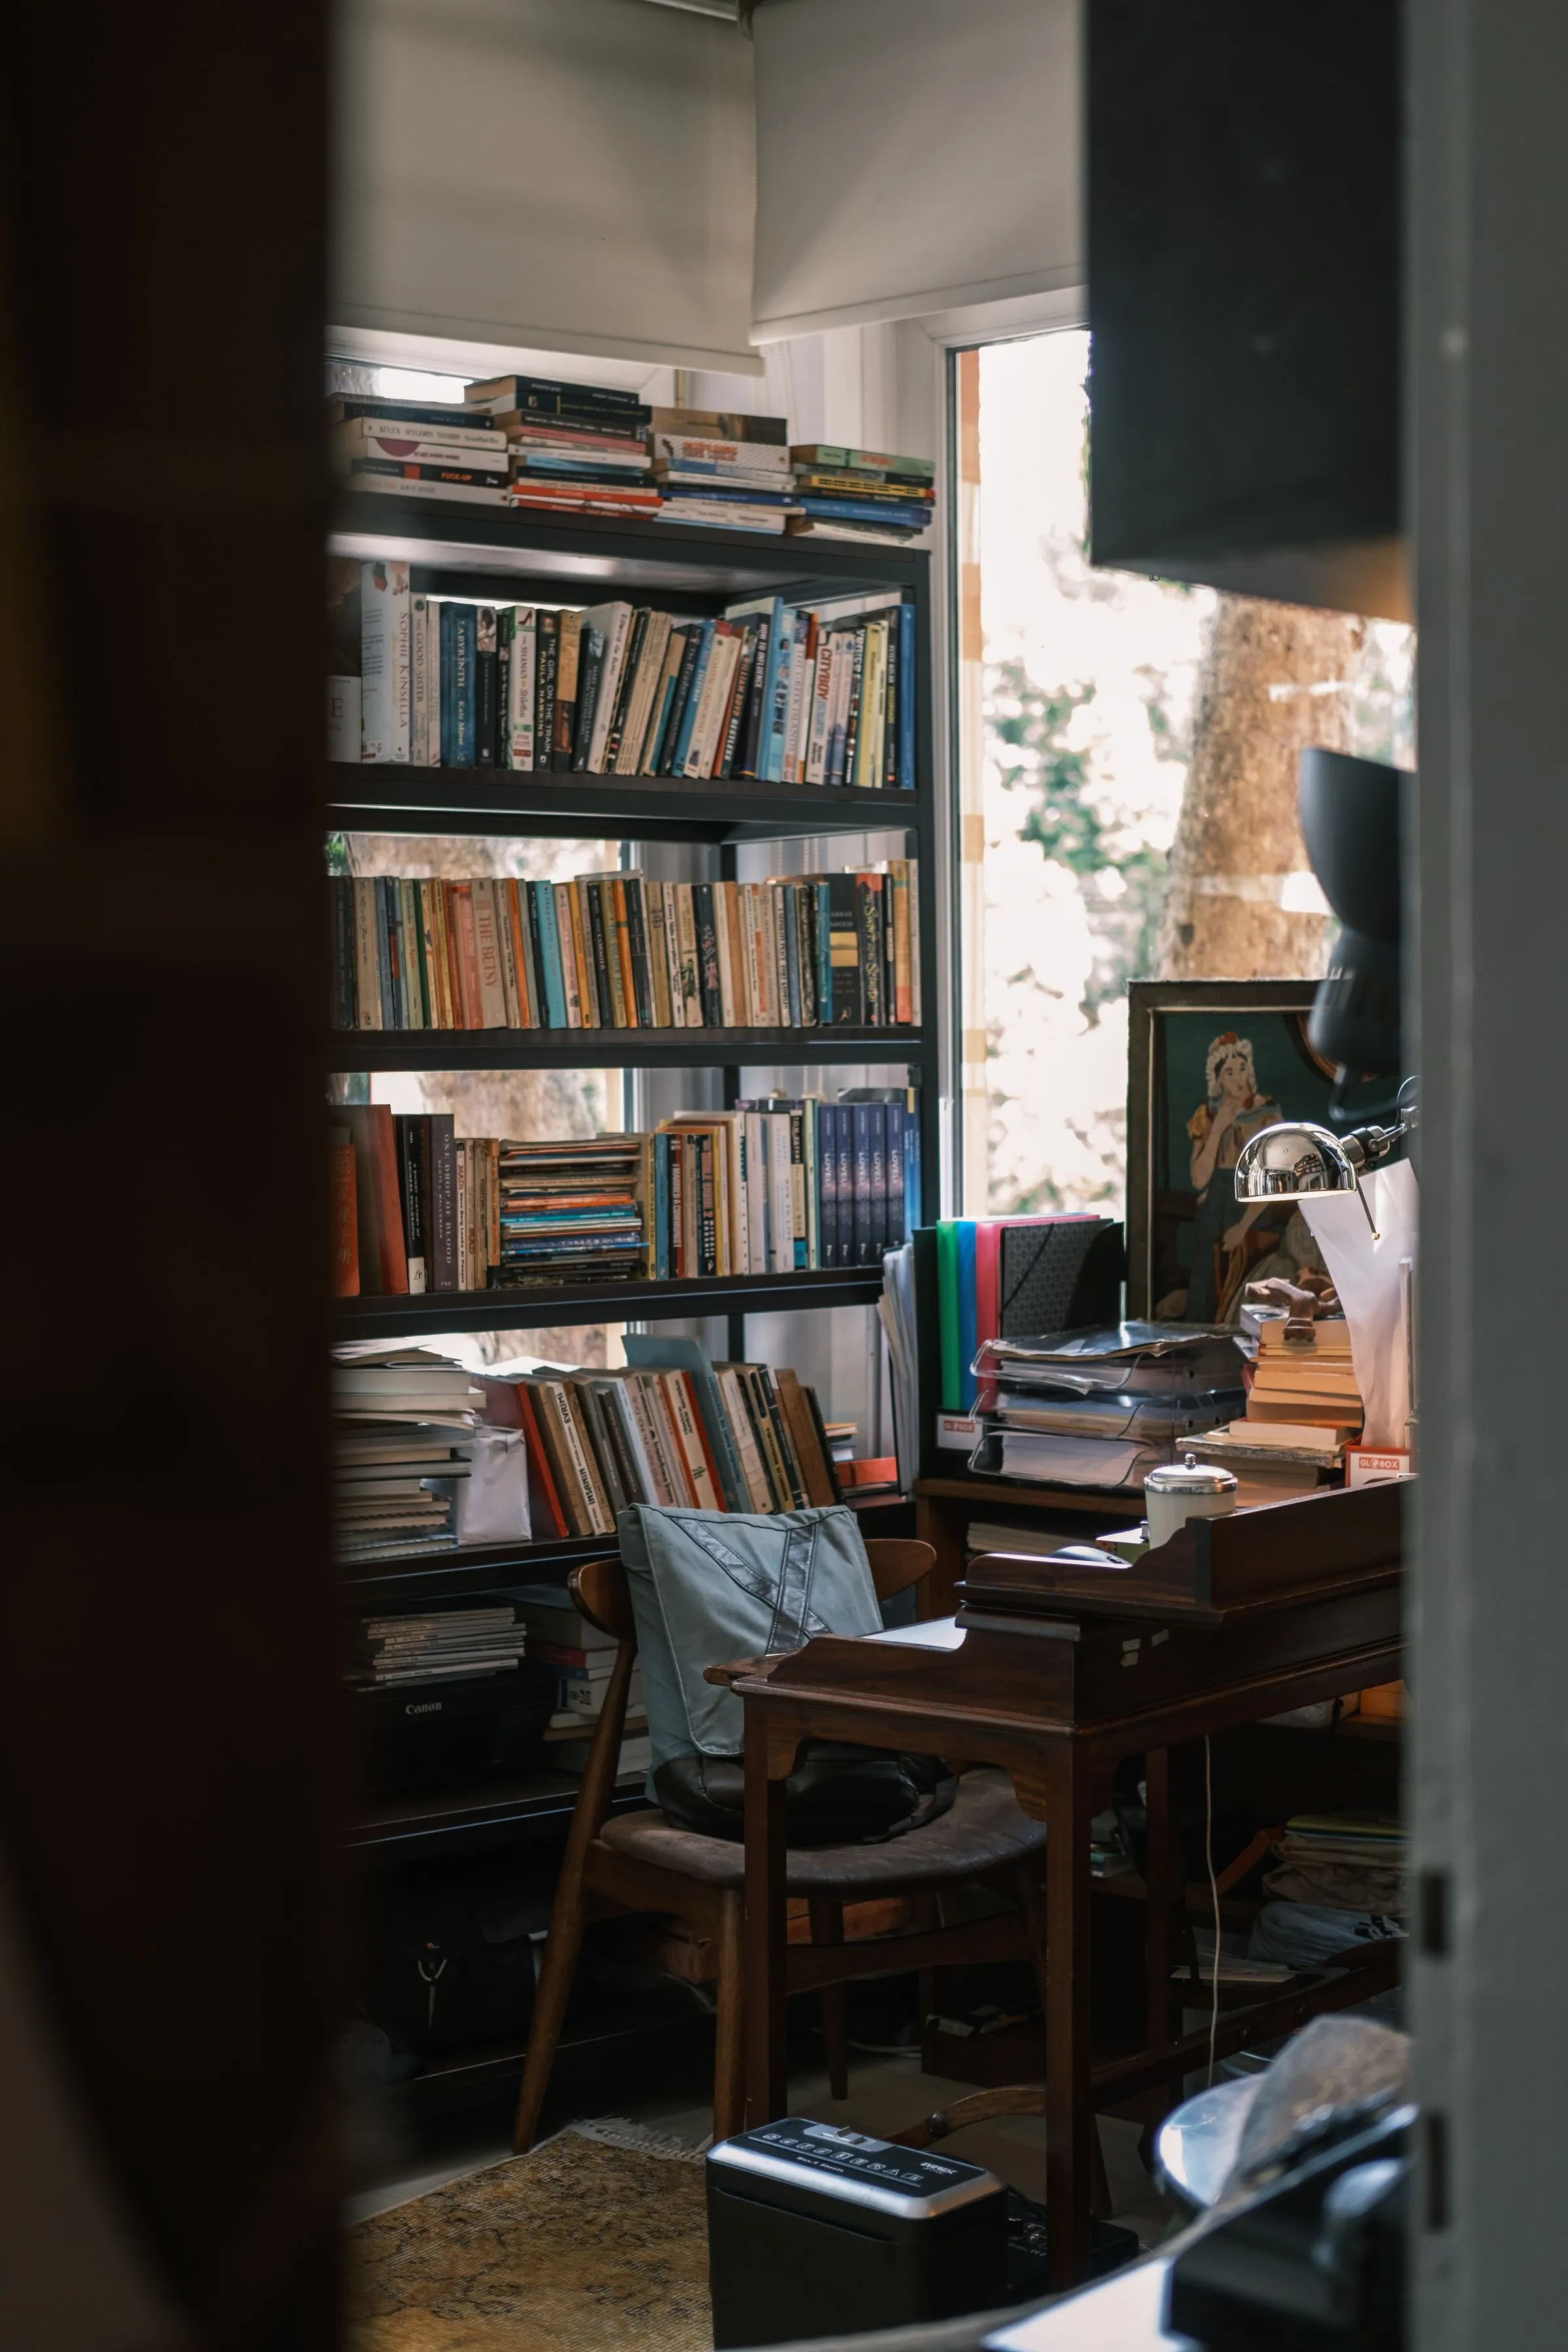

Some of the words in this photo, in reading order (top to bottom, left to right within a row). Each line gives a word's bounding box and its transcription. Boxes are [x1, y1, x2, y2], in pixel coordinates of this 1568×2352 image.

[399, 612, 410, 659] SOPHIE
[615, 614, 628, 642] Edward
[759, 624, 768, 640] HOW
[416, 633, 425, 666] GOOD
[547, 638, 556, 657] THE
[613, 644, 621, 655] de
[759, 642, 766, 650] TO
[796, 649, 804, 667] THE
[546, 660, 555, 681] GIRL
[680, 664, 694, 695] Reader
[708, 653, 721, 684] COASTAL
[737, 657, 751, 693] WILLIAM
[754, 651, 766, 689] INFLUENCE
[817, 647, 833, 700] CITYBOY
[399, 665, 410, 728] KINSELLA
[414, 667, 425, 703] SISTER
[546, 685, 554, 699] ON
[693, 669, 704, 703] EVERYMAN
[546, 702, 554, 721] THE
[698, 688, 713, 733] CALIFORNIA
[732, 694, 743, 717] BOYD
[544, 724, 553, 752] TRAIN
[724, 718, 738, 761] RESTLESS
[788, 708, 800, 752] ISLANDS
[479, 915, 494, 943] THE
[596, 934, 605, 971] CORMIER
[482, 947, 498, 988] BETSY
[445, 1201, 451, 1217] OF
[786, 1205, 791, 1215] TO
[416, 1228, 420, 1237] OF
[674, 1205, 682, 1247] COMMUNIST
[405, 1701, 442, 1715] Canon
